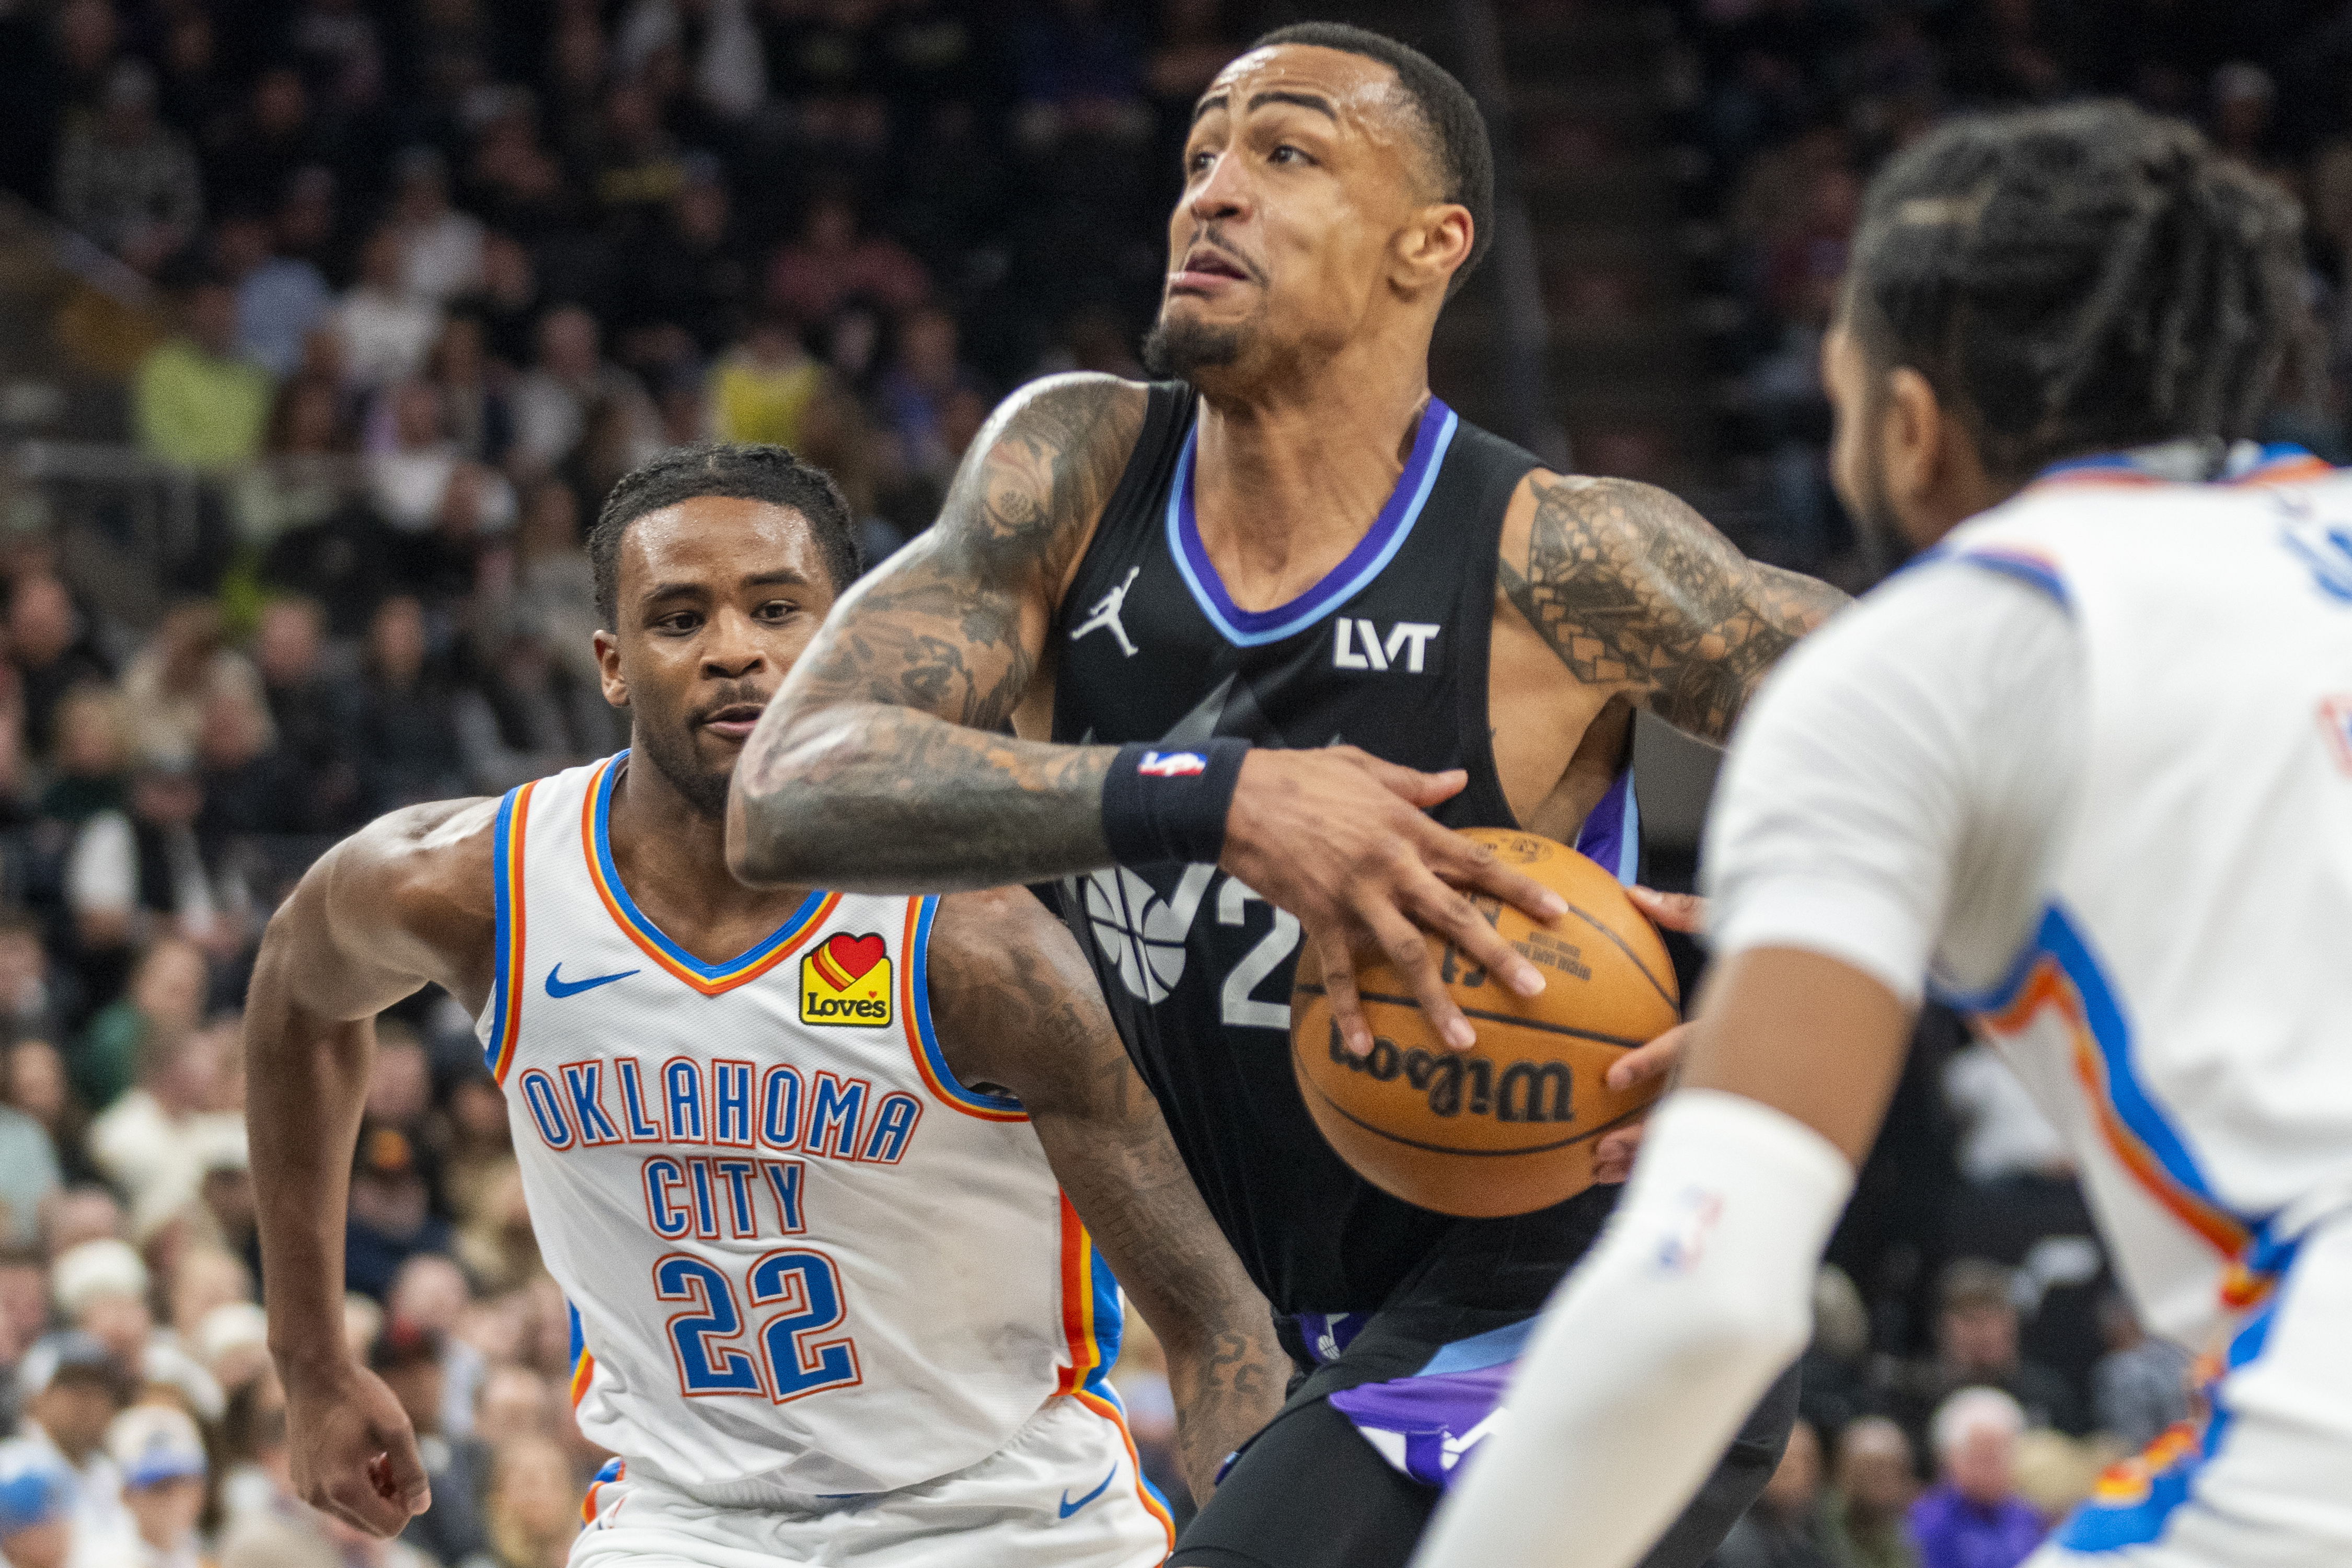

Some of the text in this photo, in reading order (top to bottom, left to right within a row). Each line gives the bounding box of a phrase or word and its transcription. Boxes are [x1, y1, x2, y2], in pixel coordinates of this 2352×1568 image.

[1333, 617, 1440, 673] LVT
[520, 1056, 924, 1165] OKLAHOMA
[1330, 1014, 1575, 1123] Wilson
[641, 1155, 806, 1240] CITY
[652, 1248, 863, 1405] 22
